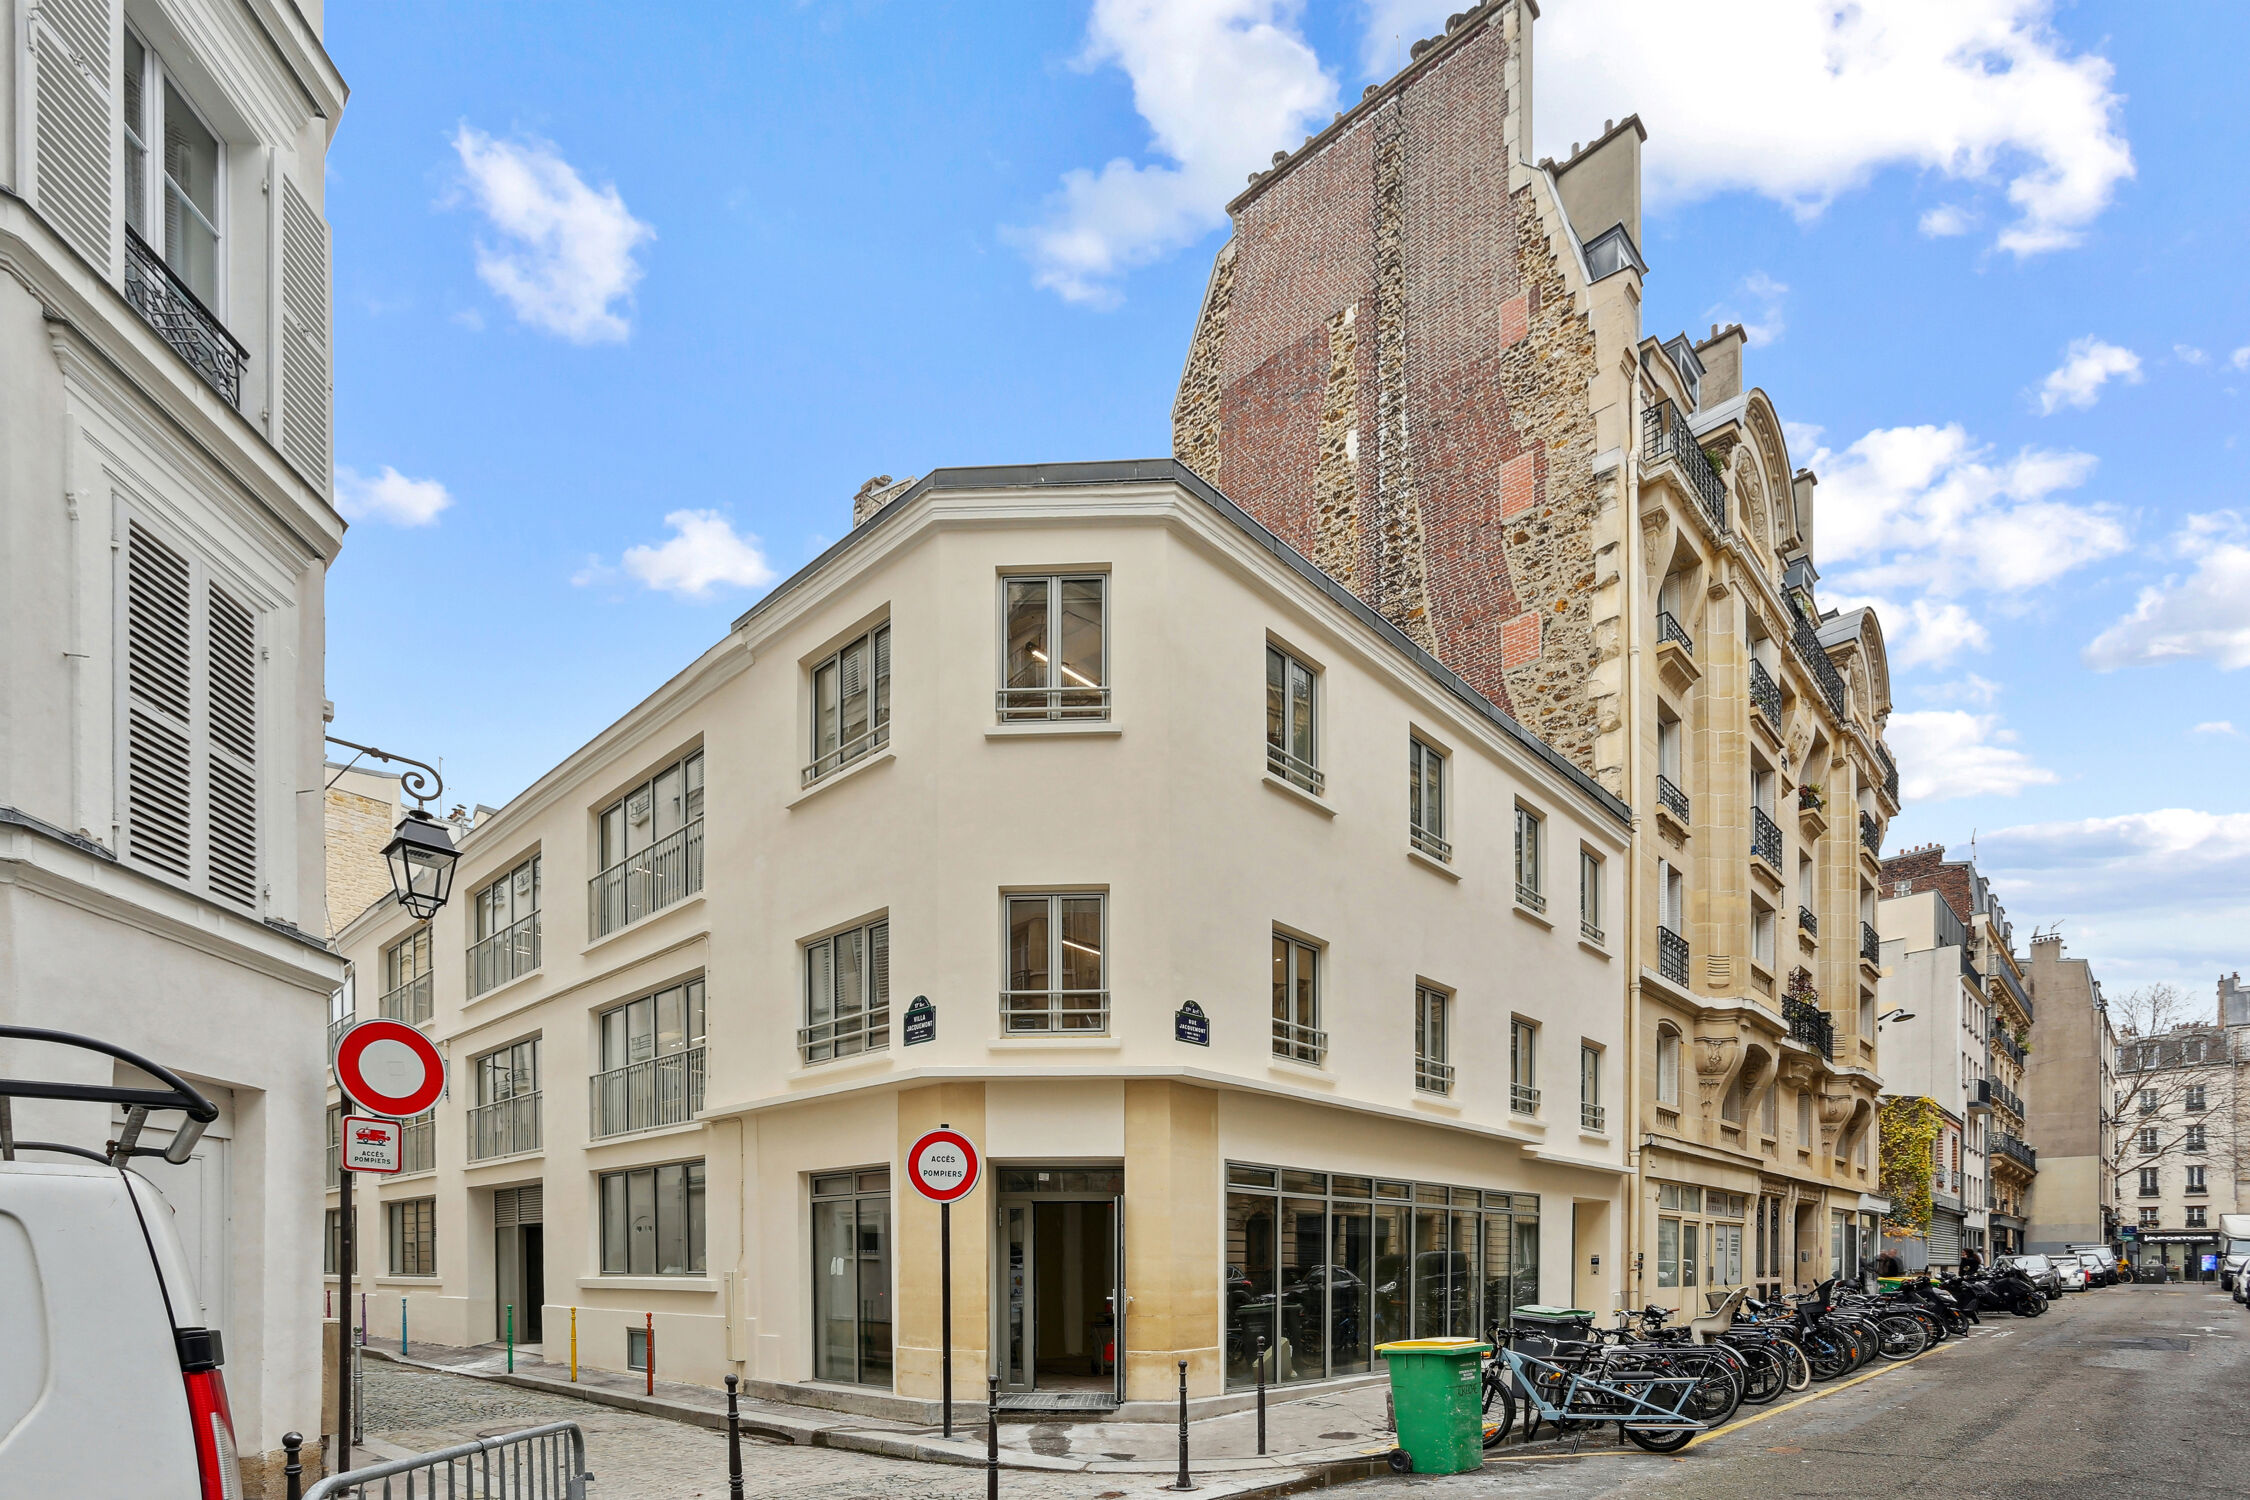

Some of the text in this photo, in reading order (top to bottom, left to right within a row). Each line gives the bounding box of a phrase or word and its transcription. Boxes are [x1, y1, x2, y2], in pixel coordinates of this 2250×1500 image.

[906, 1020, 933, 1032] JACQUEMONT
[1179, 1023, 1206, 1034] JACQUEMONT
[354, 1156, 391, 1164] POMPIERS
[923, 1169, 962, 1178] POMPIERS
[2144, 1234, 2213, 1242] VAPOSTORE
